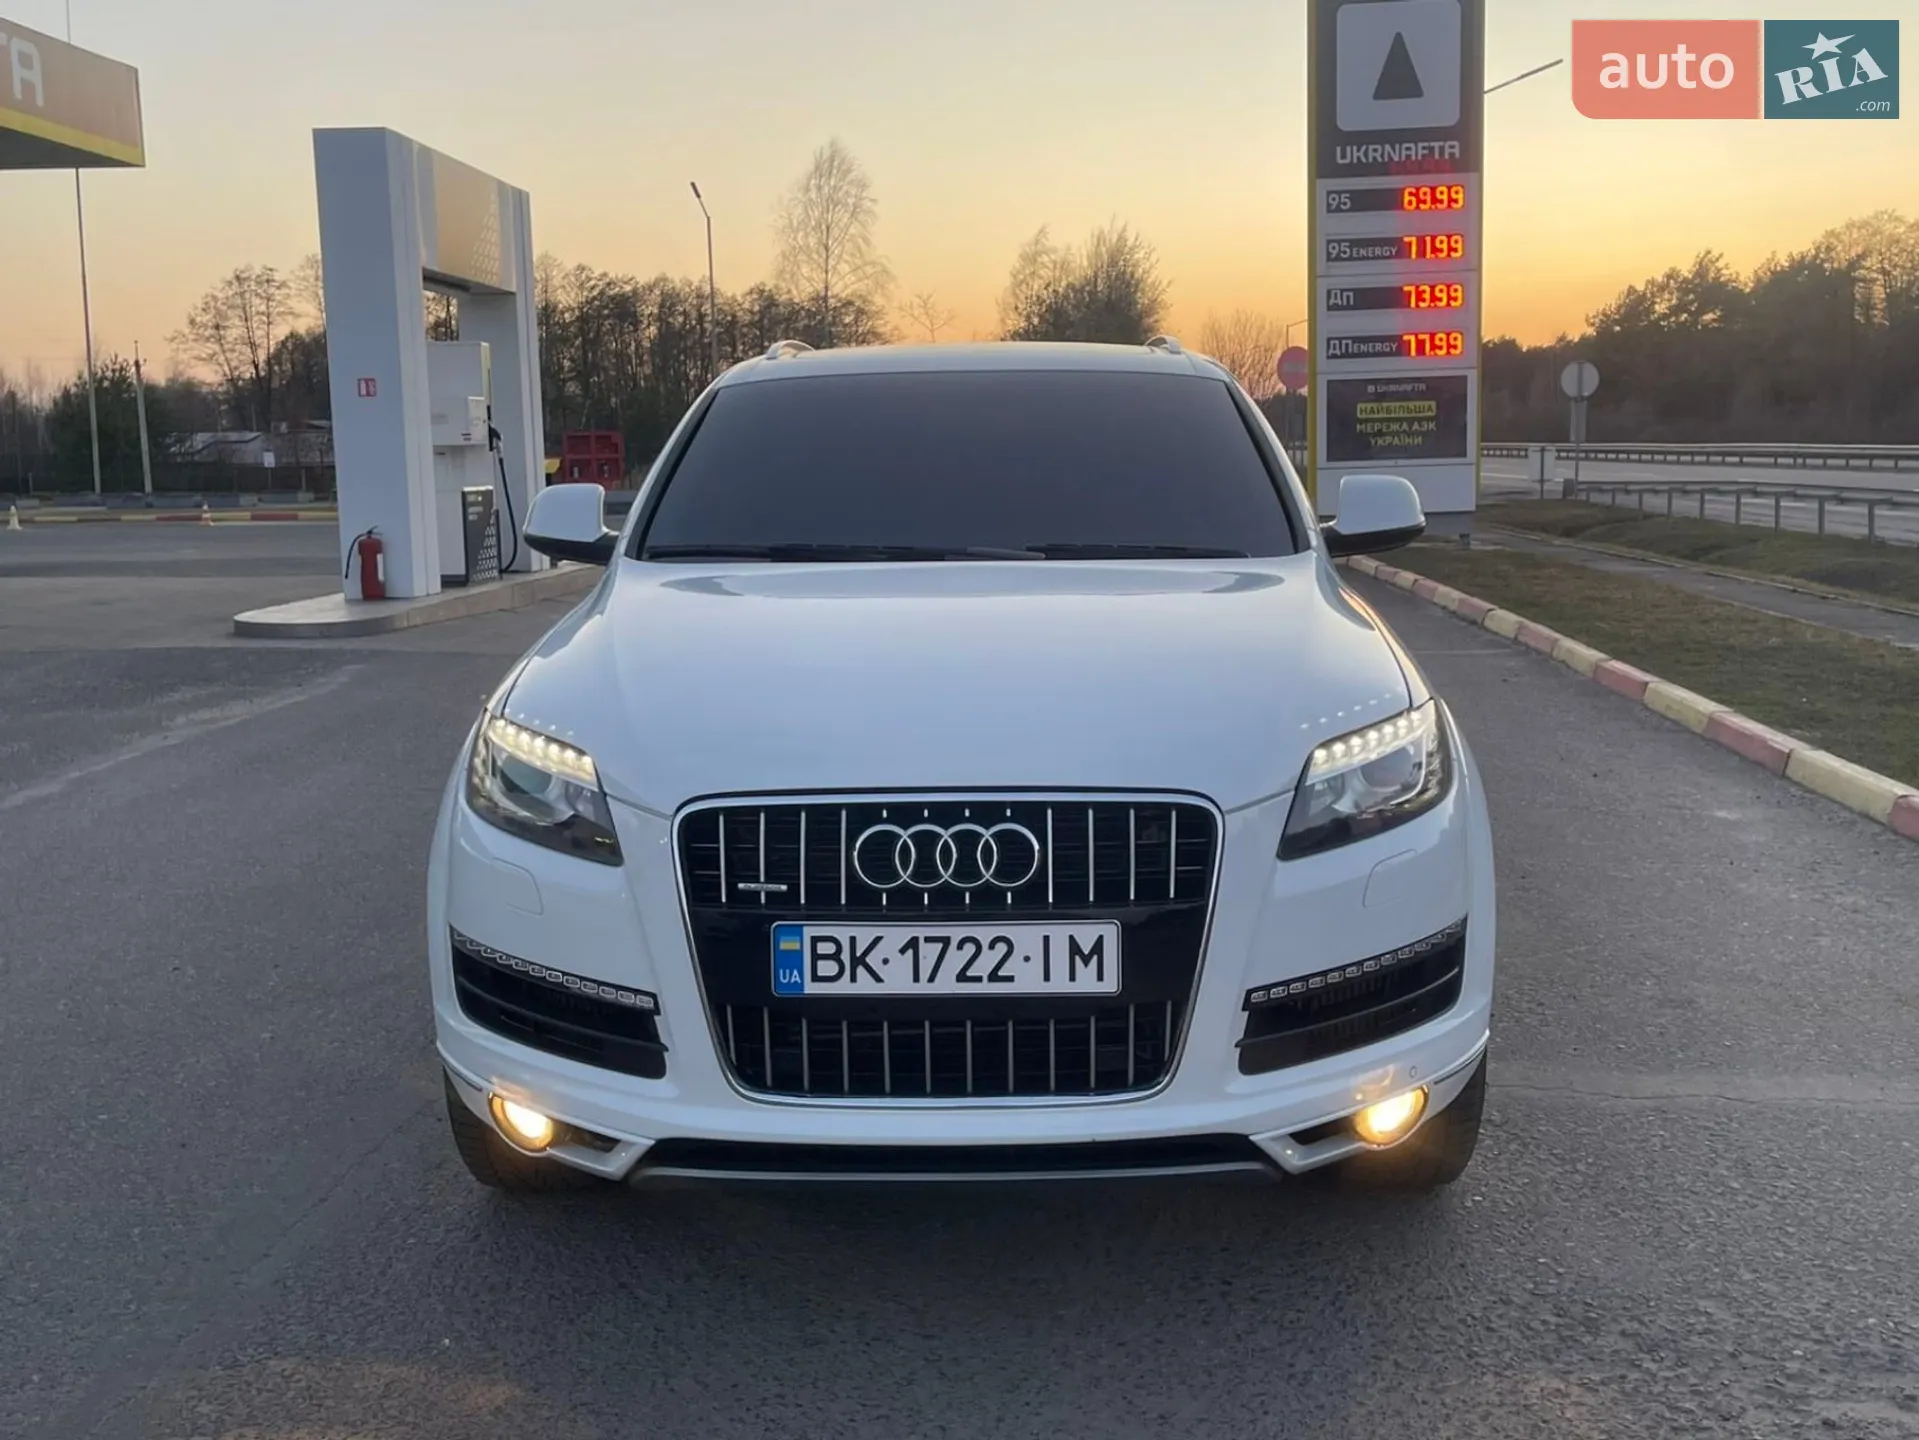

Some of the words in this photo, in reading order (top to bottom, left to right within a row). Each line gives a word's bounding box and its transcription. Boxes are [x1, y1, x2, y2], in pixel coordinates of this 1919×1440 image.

[1336, 141, 1460, 164] UKRNAFTA
[1328, 193, 1351, 210] 95
[1403, 185, 1465, 210] 69.99
[1328, 242, 1351, 259] 95
[1352, 246, 1398, 257] ENERGY
[1403, 235, 1464, 260] 71.99
[1328, 289, 1354, 306] ДП
[1403, 284, 1463, 309] 73.99
[1353, 341, 1398, 354] ENERGY
[1402, 332, 1463, 357] 77.99
[1356, 421, 1409, 433] МЕРЕЖА
[1412, 421, 1436, 432] АЗК
[779, 969, 801, 984] UA
